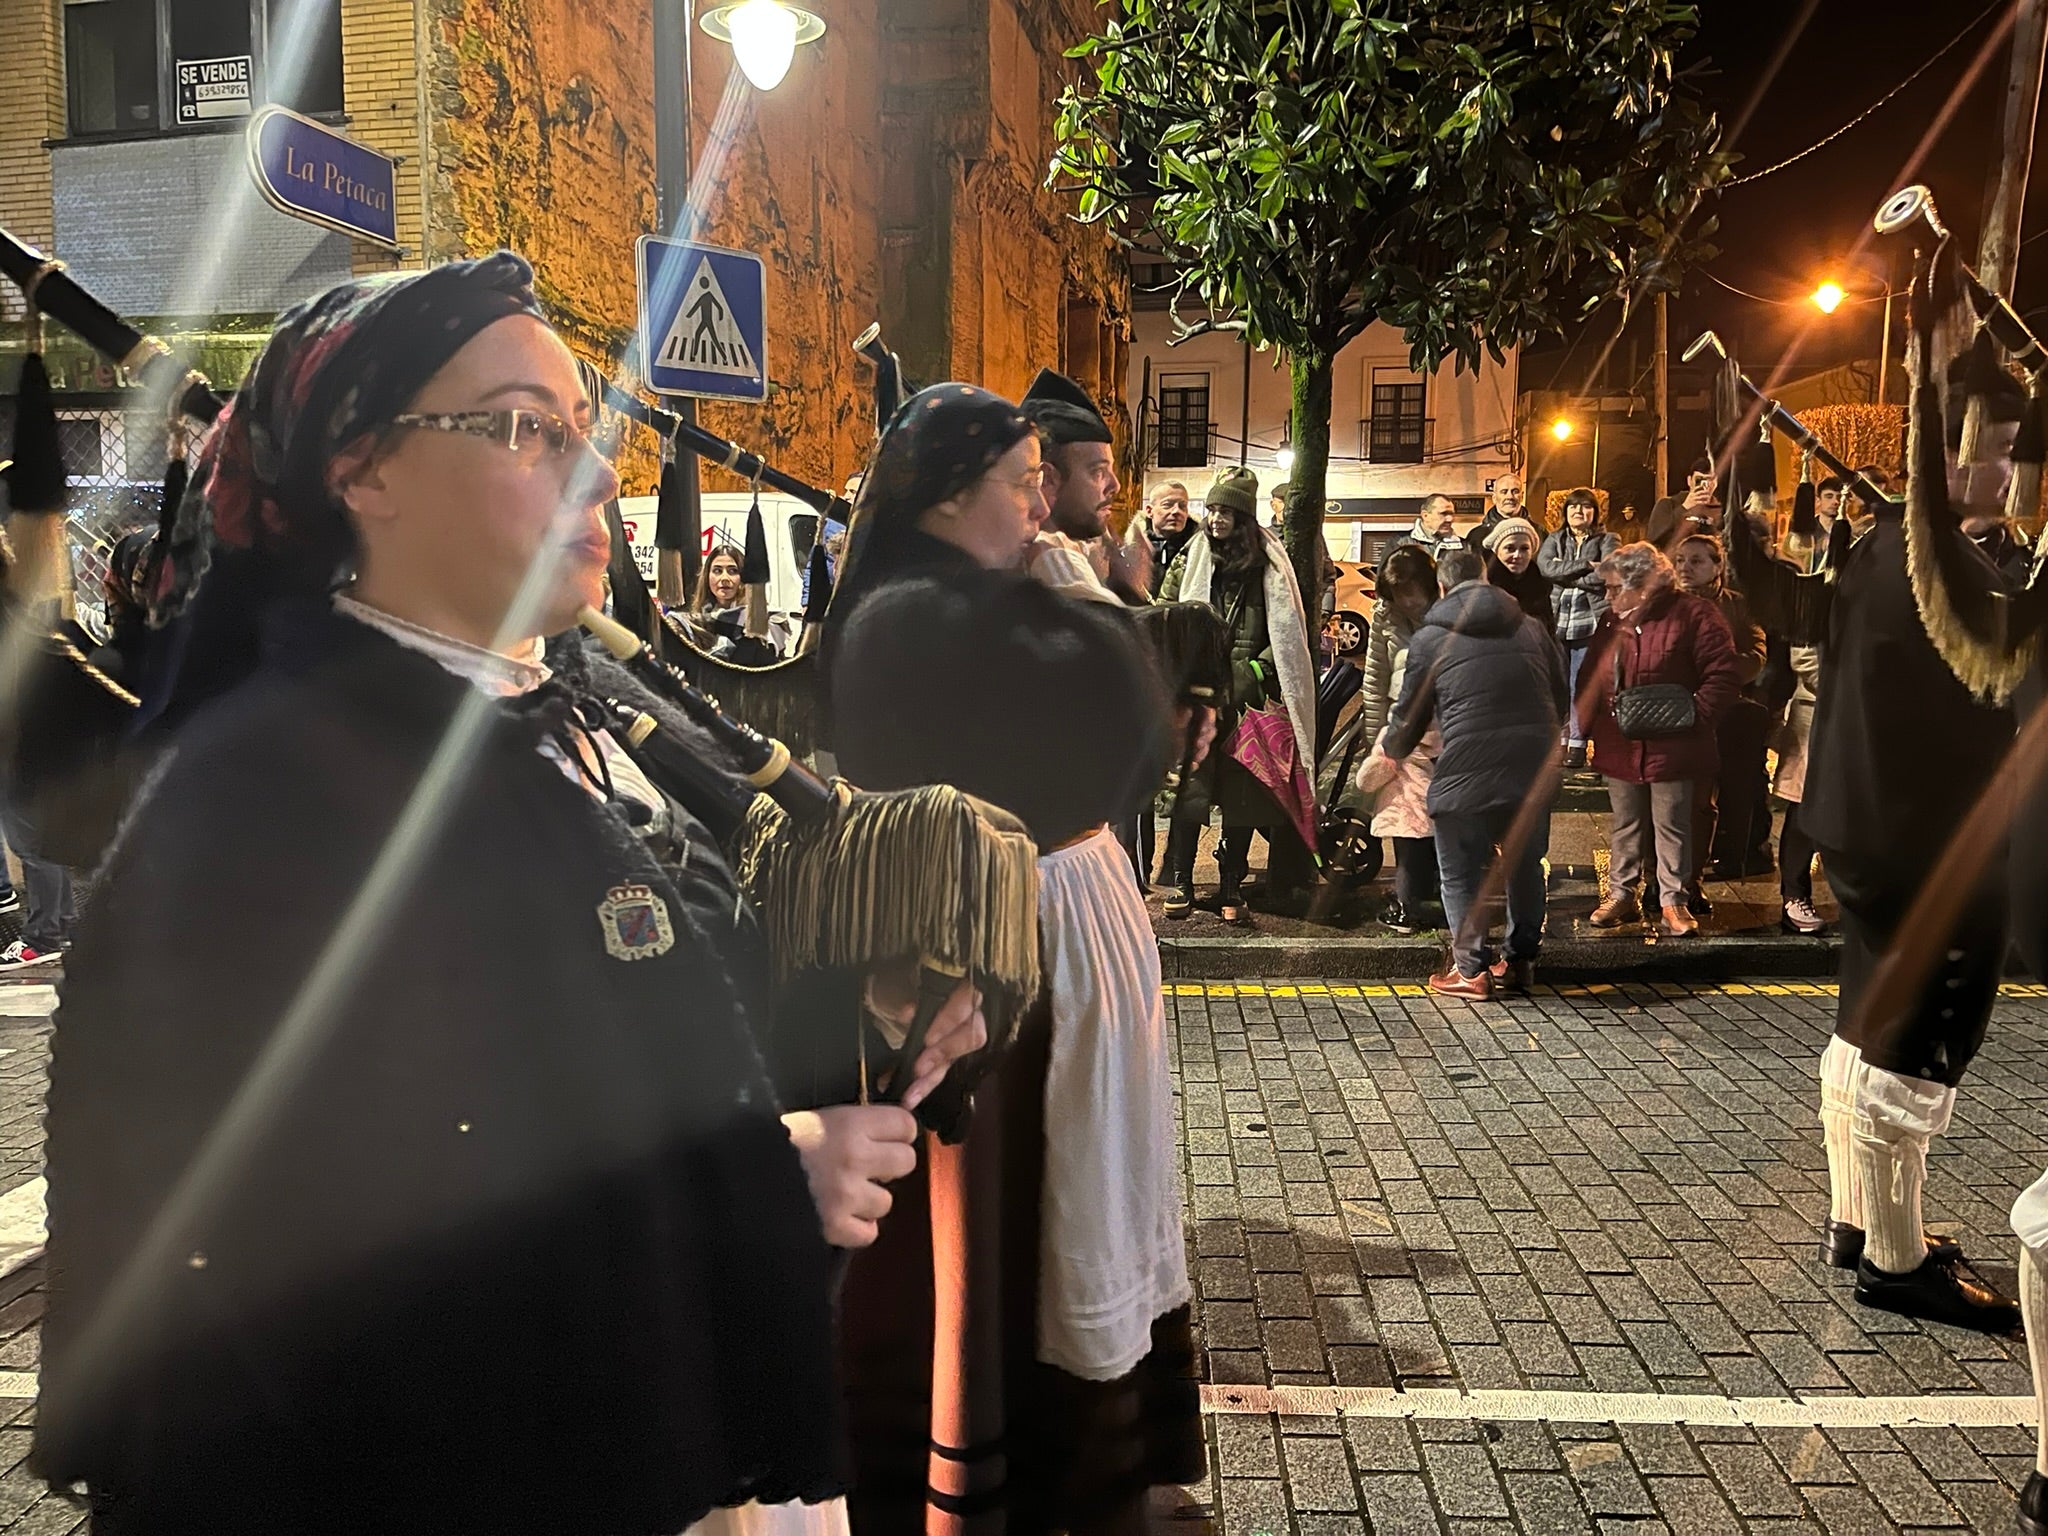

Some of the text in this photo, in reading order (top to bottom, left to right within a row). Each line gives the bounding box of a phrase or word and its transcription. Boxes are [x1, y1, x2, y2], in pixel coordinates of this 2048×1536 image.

[181, 61, 248, 85] SE VENDE
[286, 145, 387, 211] La Petaca
[634, 545, 655, 559] 342
